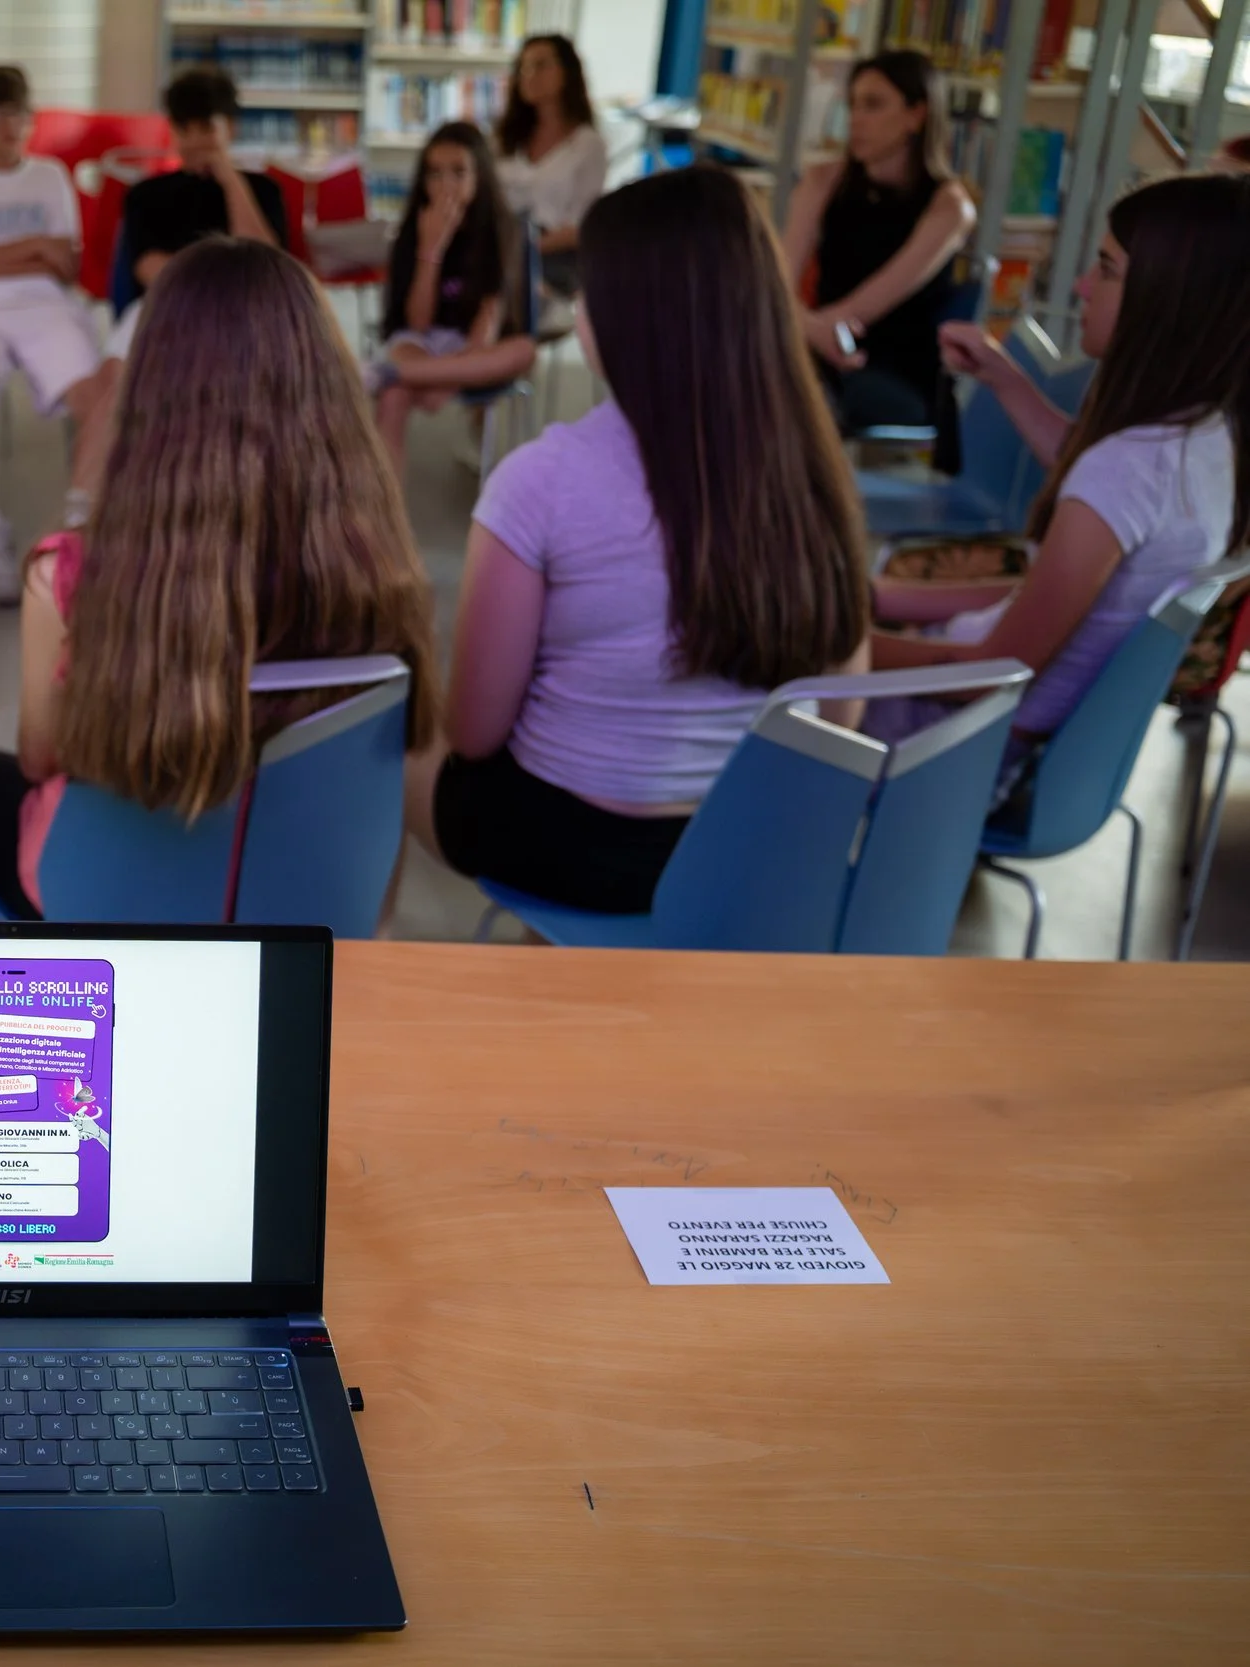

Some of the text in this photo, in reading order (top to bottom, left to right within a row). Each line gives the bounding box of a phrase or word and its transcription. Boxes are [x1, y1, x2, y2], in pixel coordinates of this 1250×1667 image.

[29, 982, 108, 994] SCROLLING
[42, 996, 94, 1007] ONLIFE
[0, 1021, 32, 1029] PUBBLICA
[46, 1024, 82, 1032] PROGETTO
[32, 1037, 62, 1048] digitale
[46, 1049, 86, 1058] Artificiale
[48, 1129, 58, 1137] IN
[20, 1224, 56, 1234] LIBERO
[668, 1220, 828, 1230] CHIUSE PER EVENTO
[679, 1234, 833, 1243] RAGAZZI SARANNO
[681, 1247, 846, 1256] SALE PER BAMBINI E
[677, 1261, 696, 1270] LE
[701, 1261, 770, 1270] MAGGIO
[776, 1261, 794, 1270] 28
